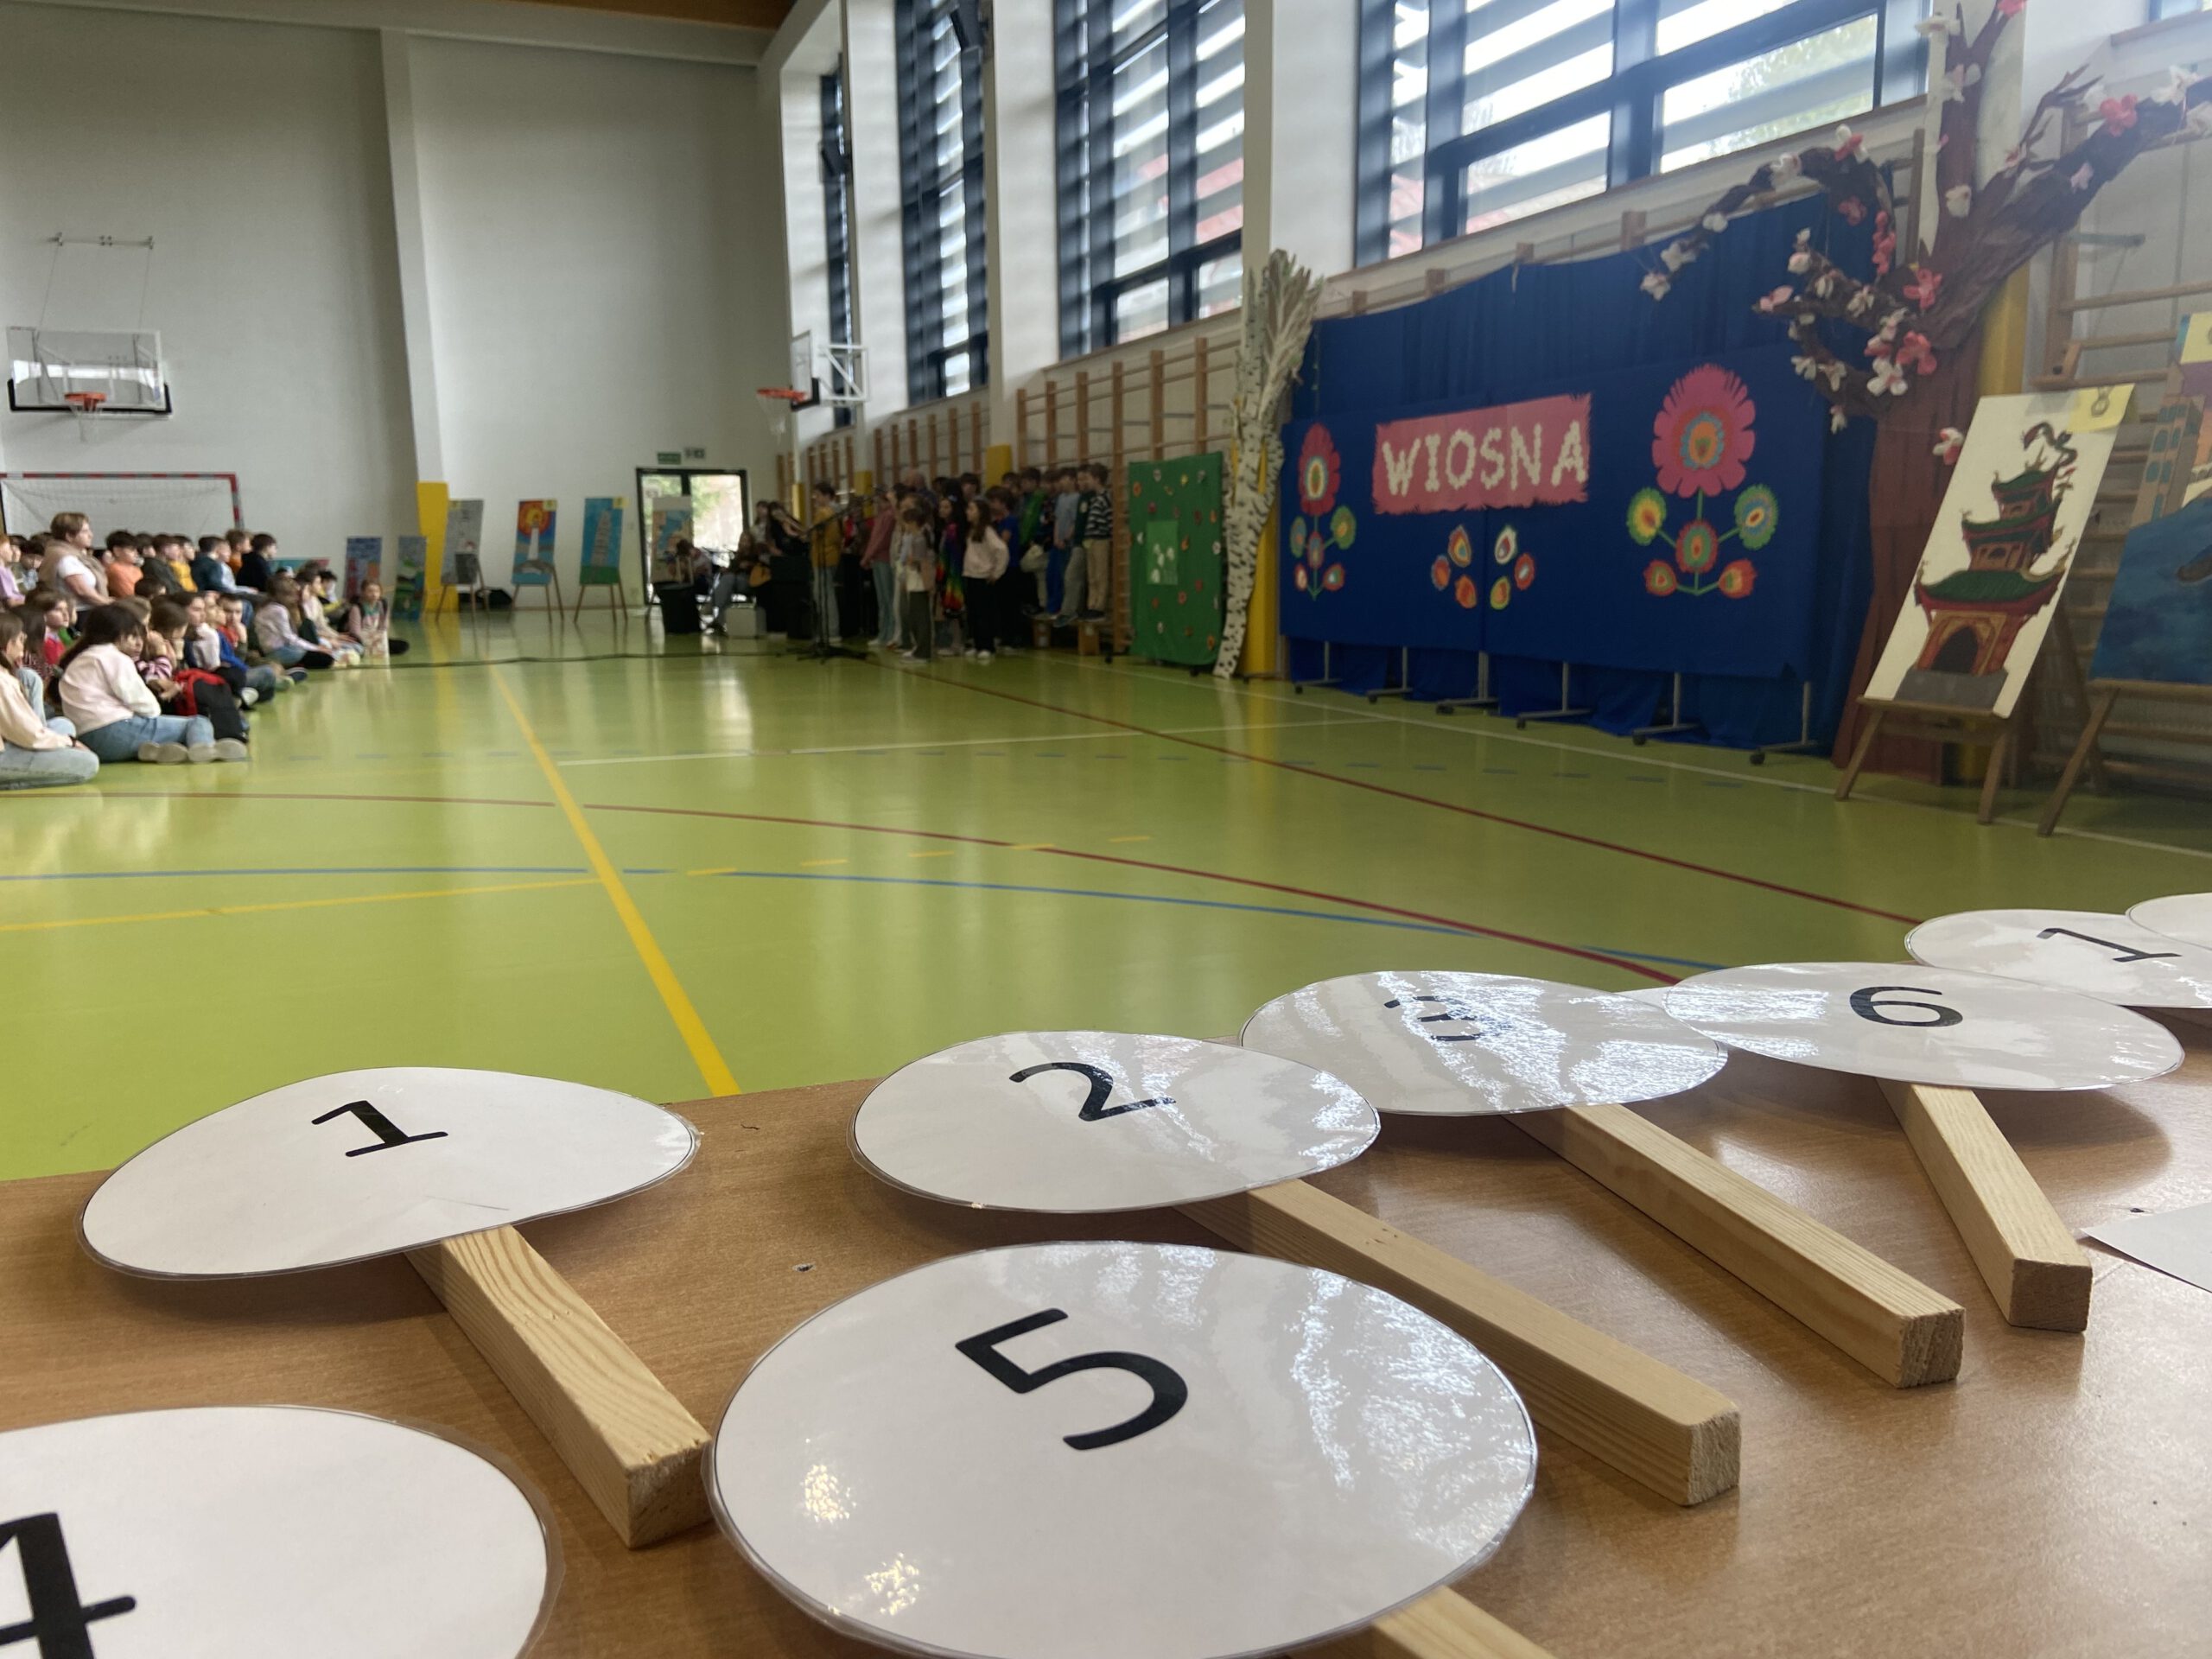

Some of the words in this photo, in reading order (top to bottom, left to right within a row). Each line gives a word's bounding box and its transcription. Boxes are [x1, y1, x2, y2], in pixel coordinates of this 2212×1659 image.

[1382, 420, 1588, 498] WIOSNA
[1383, 995, 1514, 1042] 3
[1849, 986, 1964, 1028] 6
[1009, 1061, 1172, 1122] 2
[311, 1100, 448, 1158] 1
[954, 1308, 1188, 1452] 5
